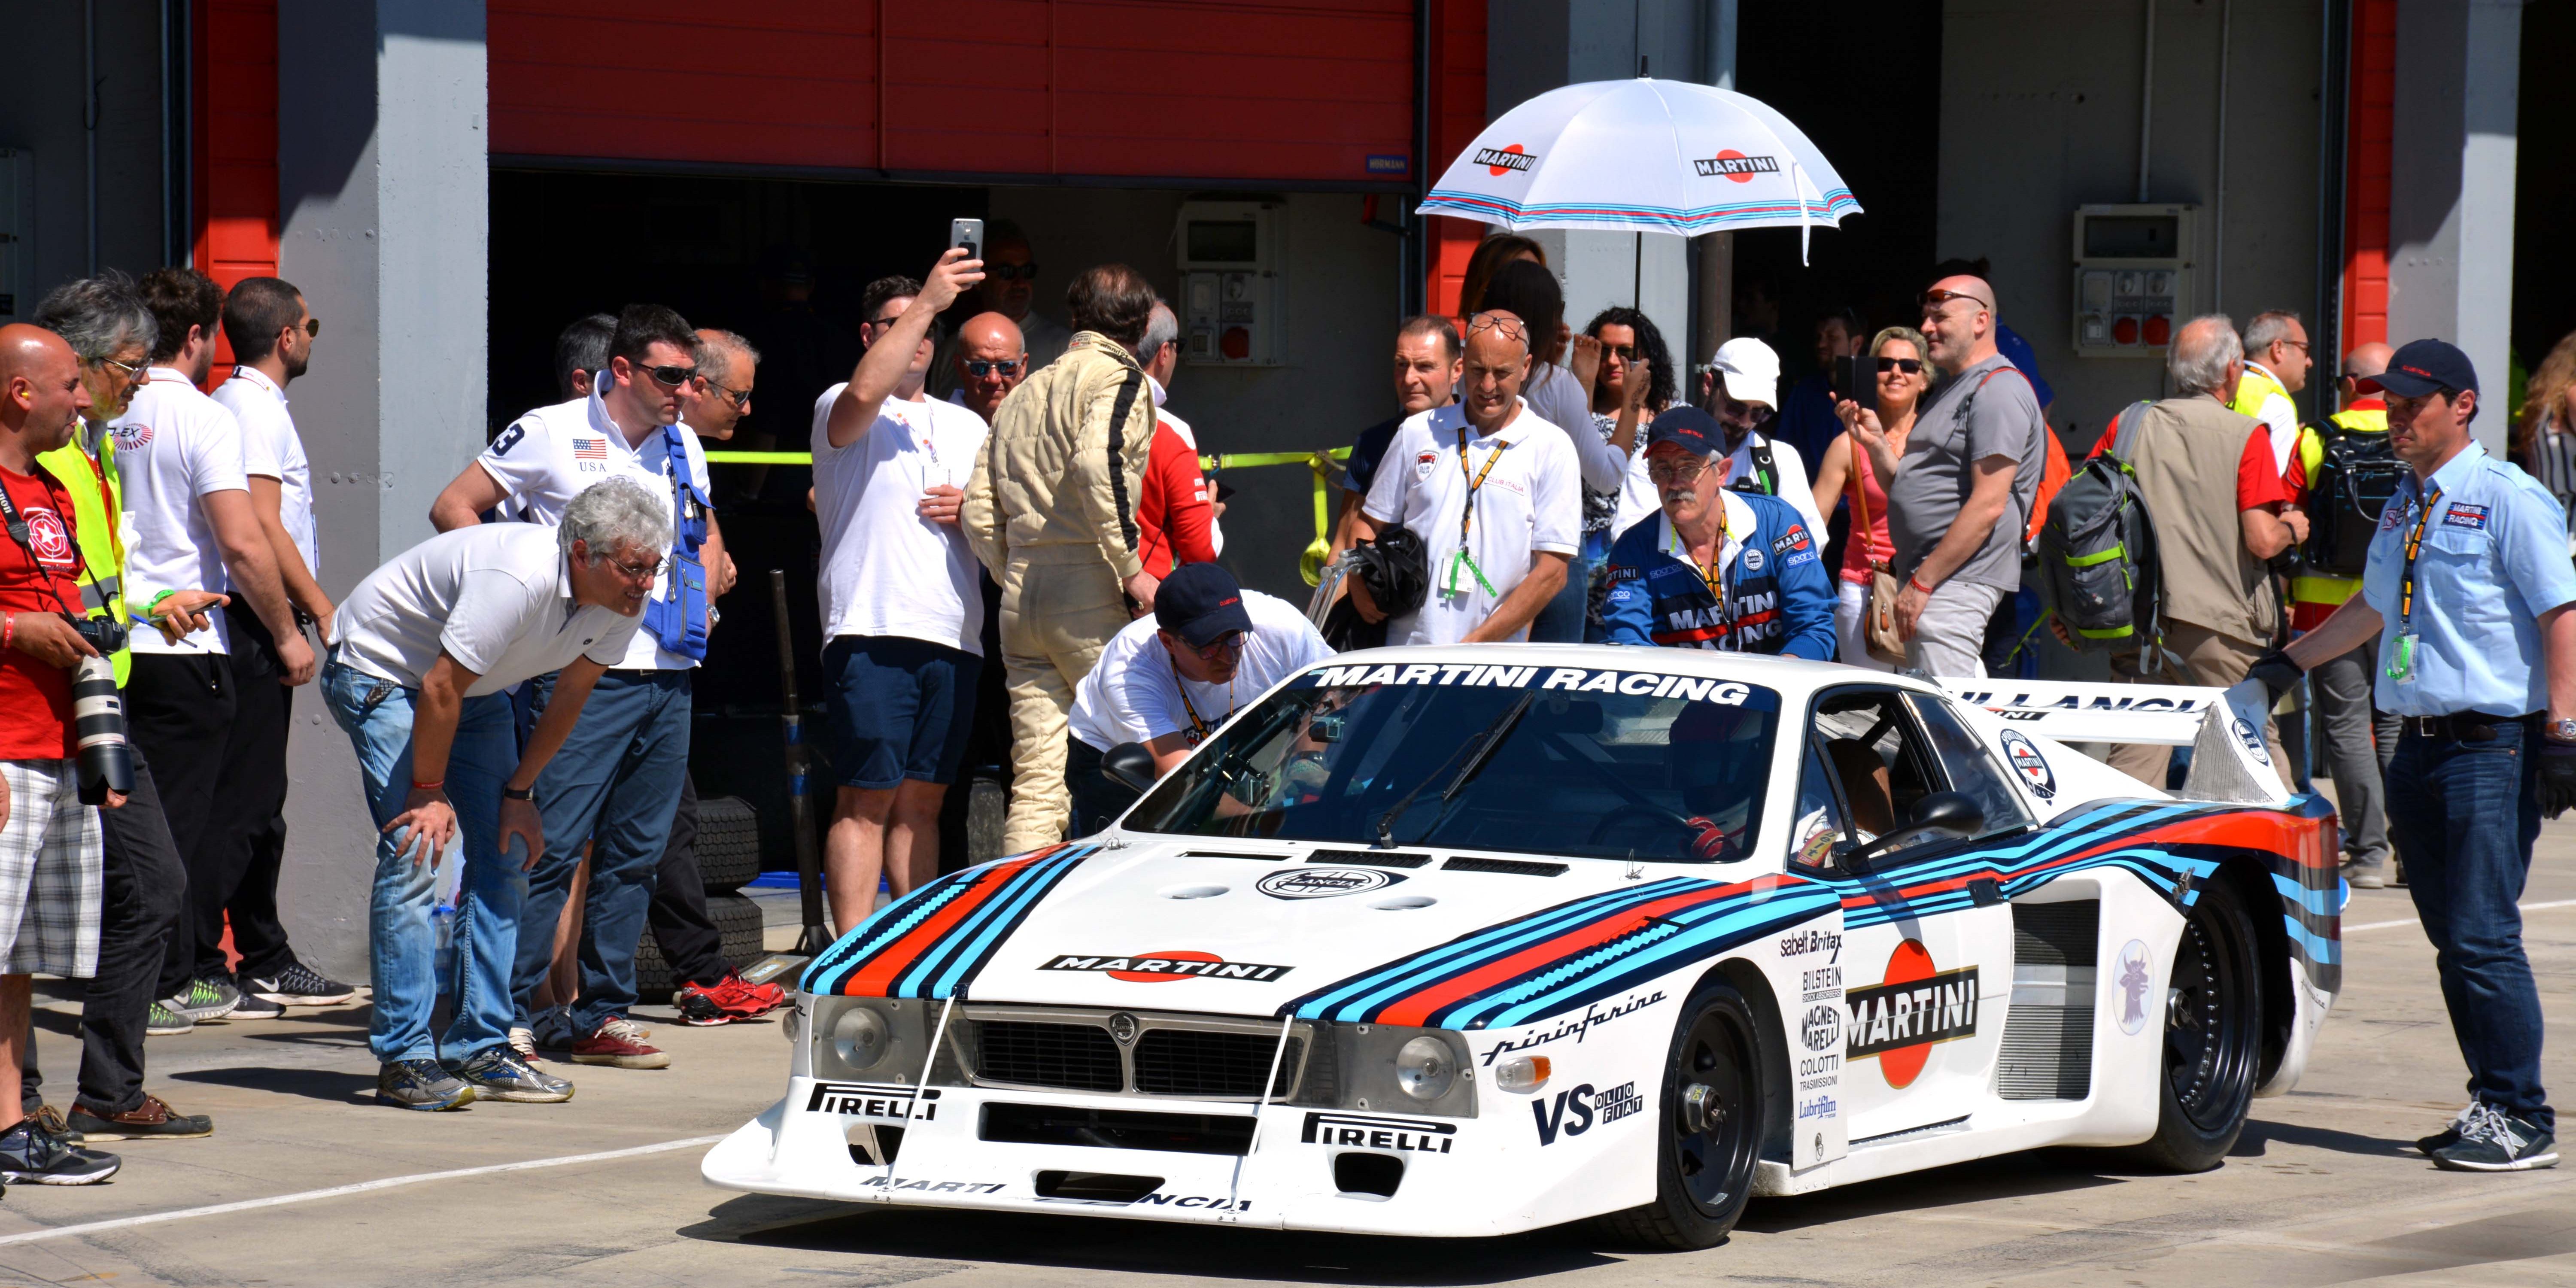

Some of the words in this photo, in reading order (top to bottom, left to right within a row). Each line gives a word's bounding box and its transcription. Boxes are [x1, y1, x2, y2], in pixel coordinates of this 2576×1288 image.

[1476, 150, 1534, 170] MARTINI
[1698, 157, 1776, 176] MARTINI
[492, 423, 525, 456] 3
[579, 462, 606, 472] USA
[1487, 476, 1504, 485] CLUB
[1505, 479, 1524, 492] ITALIA
[2448, 514, 2478, 526] RACING
[2454, 504, 2482, 515] MARTINI
[1788, 551, 1814, 565] sparc
[1606, 568, 1637, 584] RTINI
[1649, 563, 1683, 579] sparco
[1315, 665, 1538, 688] MARTINI
[1542, 668, 1751, 707] RACING
[2015, 757, 2043, 768] MARTINI
[1294, 878, 1355, 887] LANCIA
[1780, 930, 1808, 957] sabelt
[1810, 930, 1842, 965] Britax
[1054, 957, 1275, 980] MARTINI
[1803, 966, 1841, 991] BILSTEIN
[1803, 993, 1816, 1003] SHOCK
[1816, 989, 1841, 1000] ABSORBERS
[1802, 1005, 1840, 1031] MAGNETI
[1846, 979, 1975, 1049] MARTINI
[1480, 990, 1668, 1066] pininfarina
[1801, 1027, 1840, 1051] MARELLI
[1800, 1054, 1838, 1077] COLOTTI
[1800, 1075, 1838, 1092] TRASMISSIONI
[1595, 1084, 1633, 1109] OLIO
[1799, 1095, 1836, 1119] Lubrifilm
[1531, 1083, 1595, 1147] VS
[1604, 1097, 1642, 1122] FIAT
[1301, 1112, 1458, 1154] PIRELLI
[859, 1176, 1008, 1194] MARTI
[1133, 1193, 1252, 1212] NCIA
